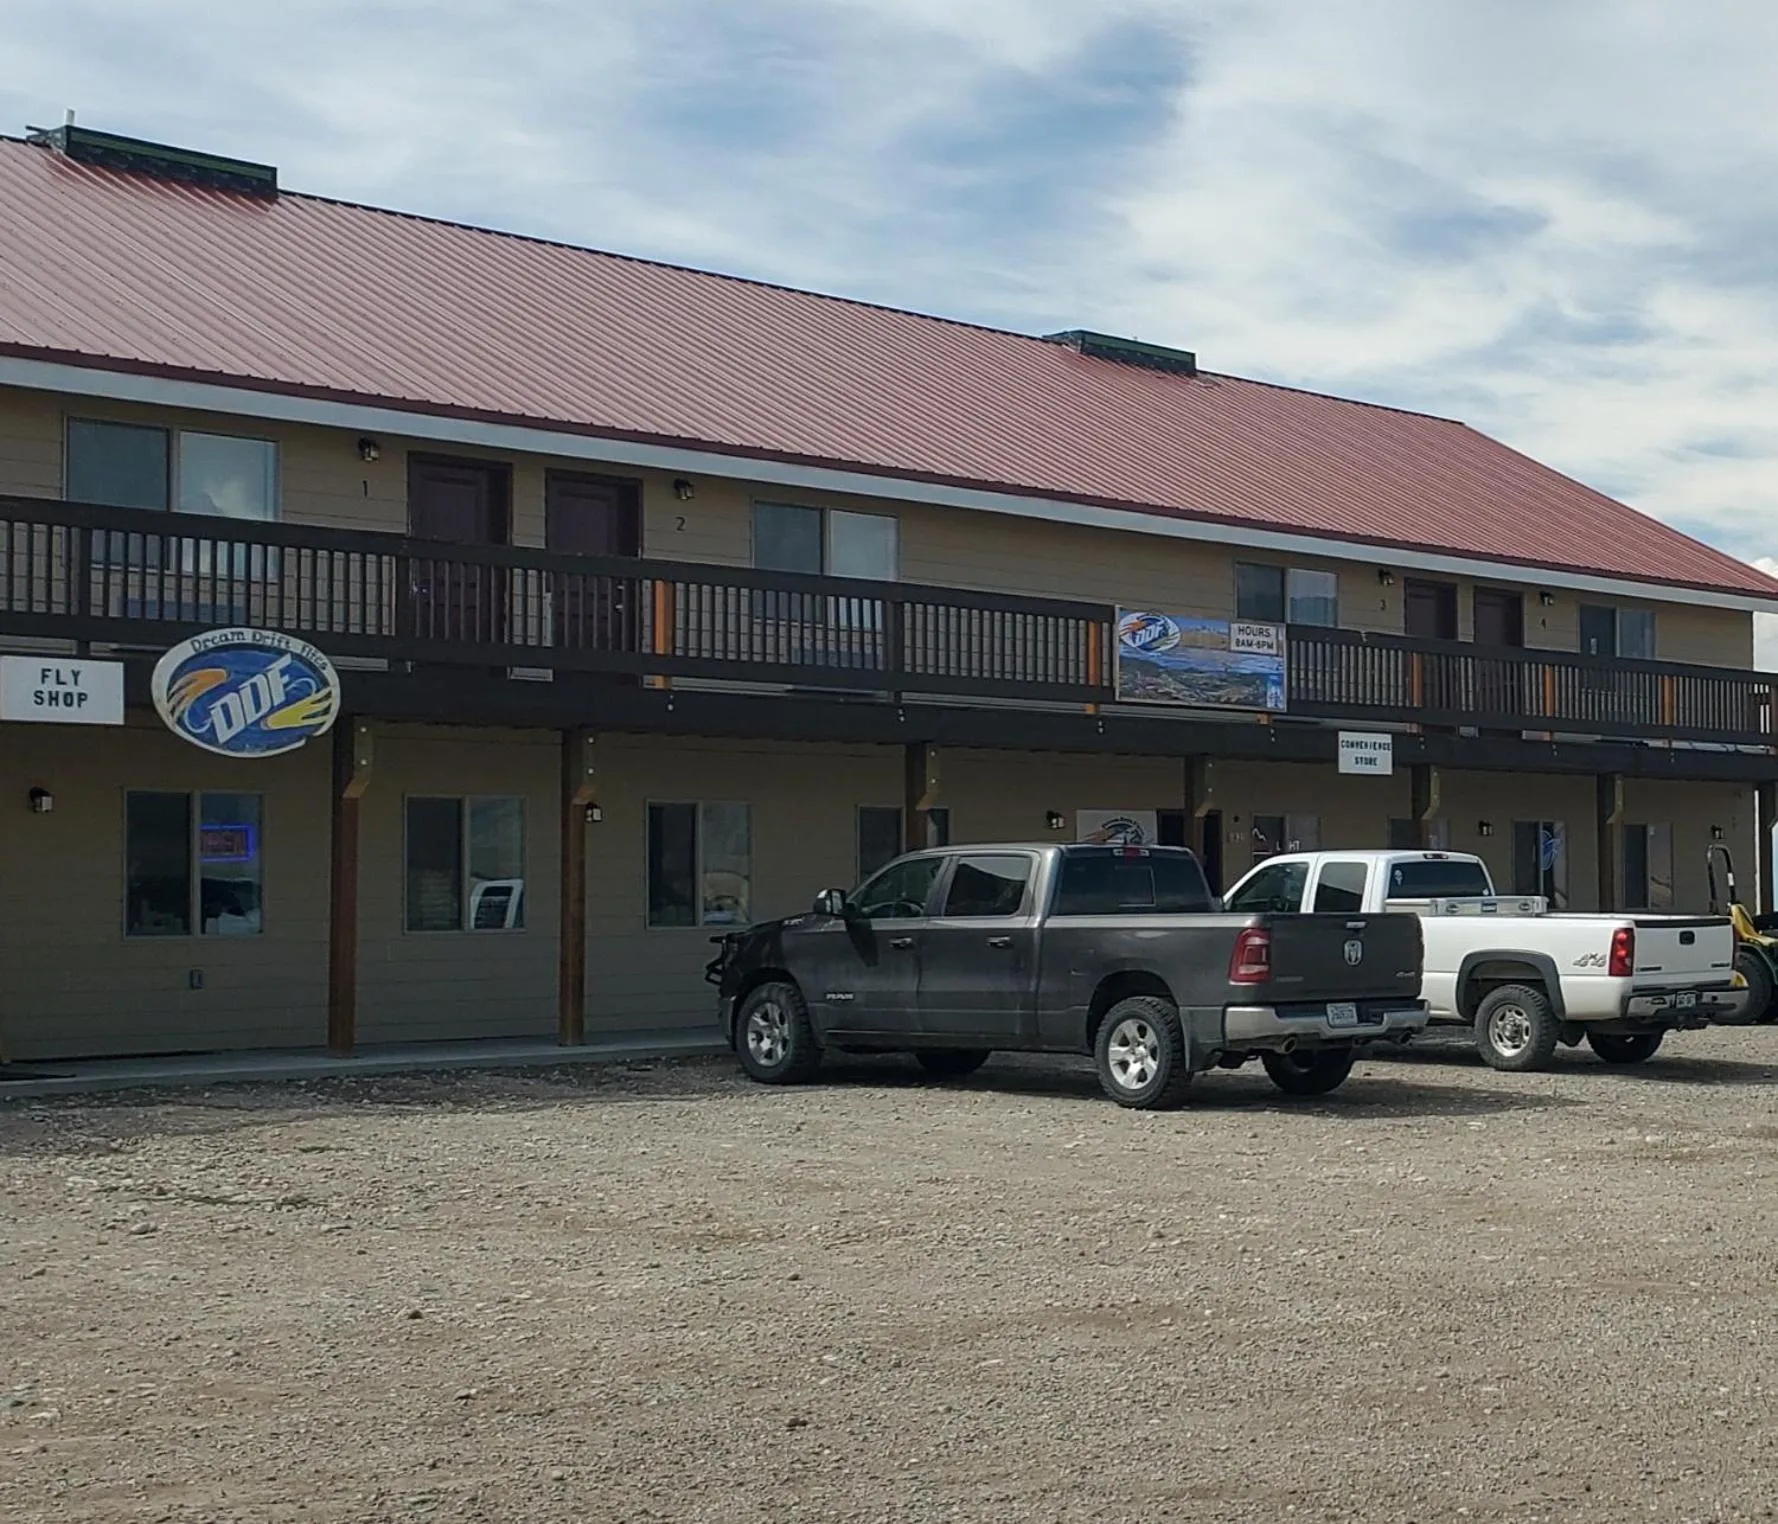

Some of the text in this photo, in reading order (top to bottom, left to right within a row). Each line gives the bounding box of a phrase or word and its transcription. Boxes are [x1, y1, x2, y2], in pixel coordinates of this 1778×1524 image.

[362, 480, 368, 497] 1
[675, 516, 686, 531] 2
[1238, 626, 1271, 638] HOURS
[190, 631, 246, 652] Dream
[251, 631, 291, 648] Drift
[41, 668, 83, 686] FLY
[33, 690, 89, 708] SHOP
[208, 652, 293, 744] DDF
[1355, 756, 1378, 766] STORE
